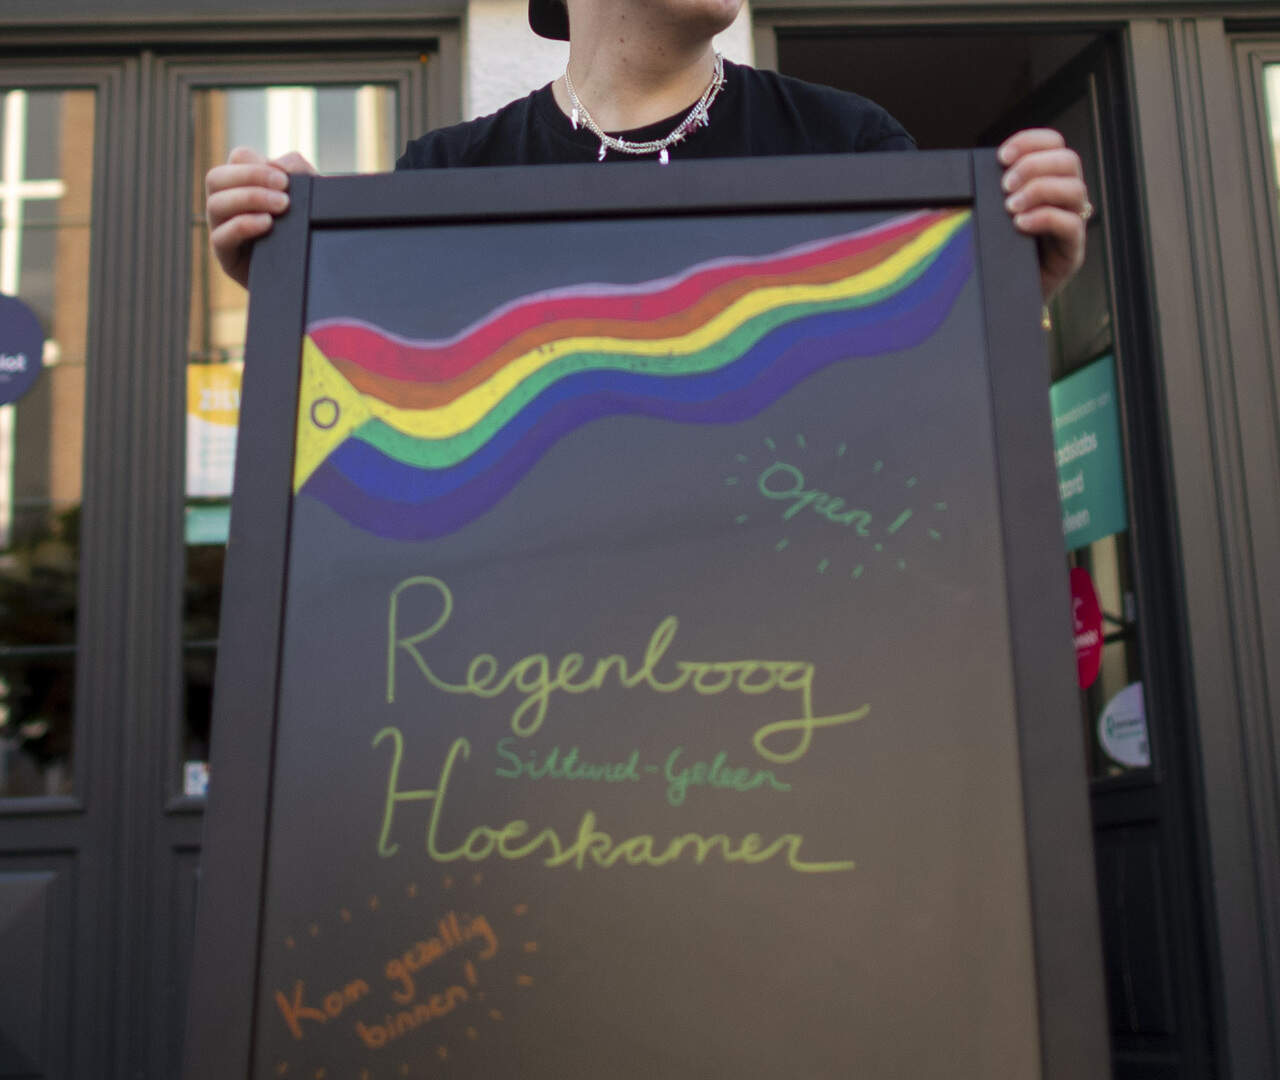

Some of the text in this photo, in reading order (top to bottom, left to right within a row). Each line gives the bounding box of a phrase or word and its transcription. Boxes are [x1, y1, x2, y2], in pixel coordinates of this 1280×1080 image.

[758, 461, 913, 552] Open!
[386, 576, 871, 764] Regenboog
[372, 726, 856, 873] Hoeskamer
